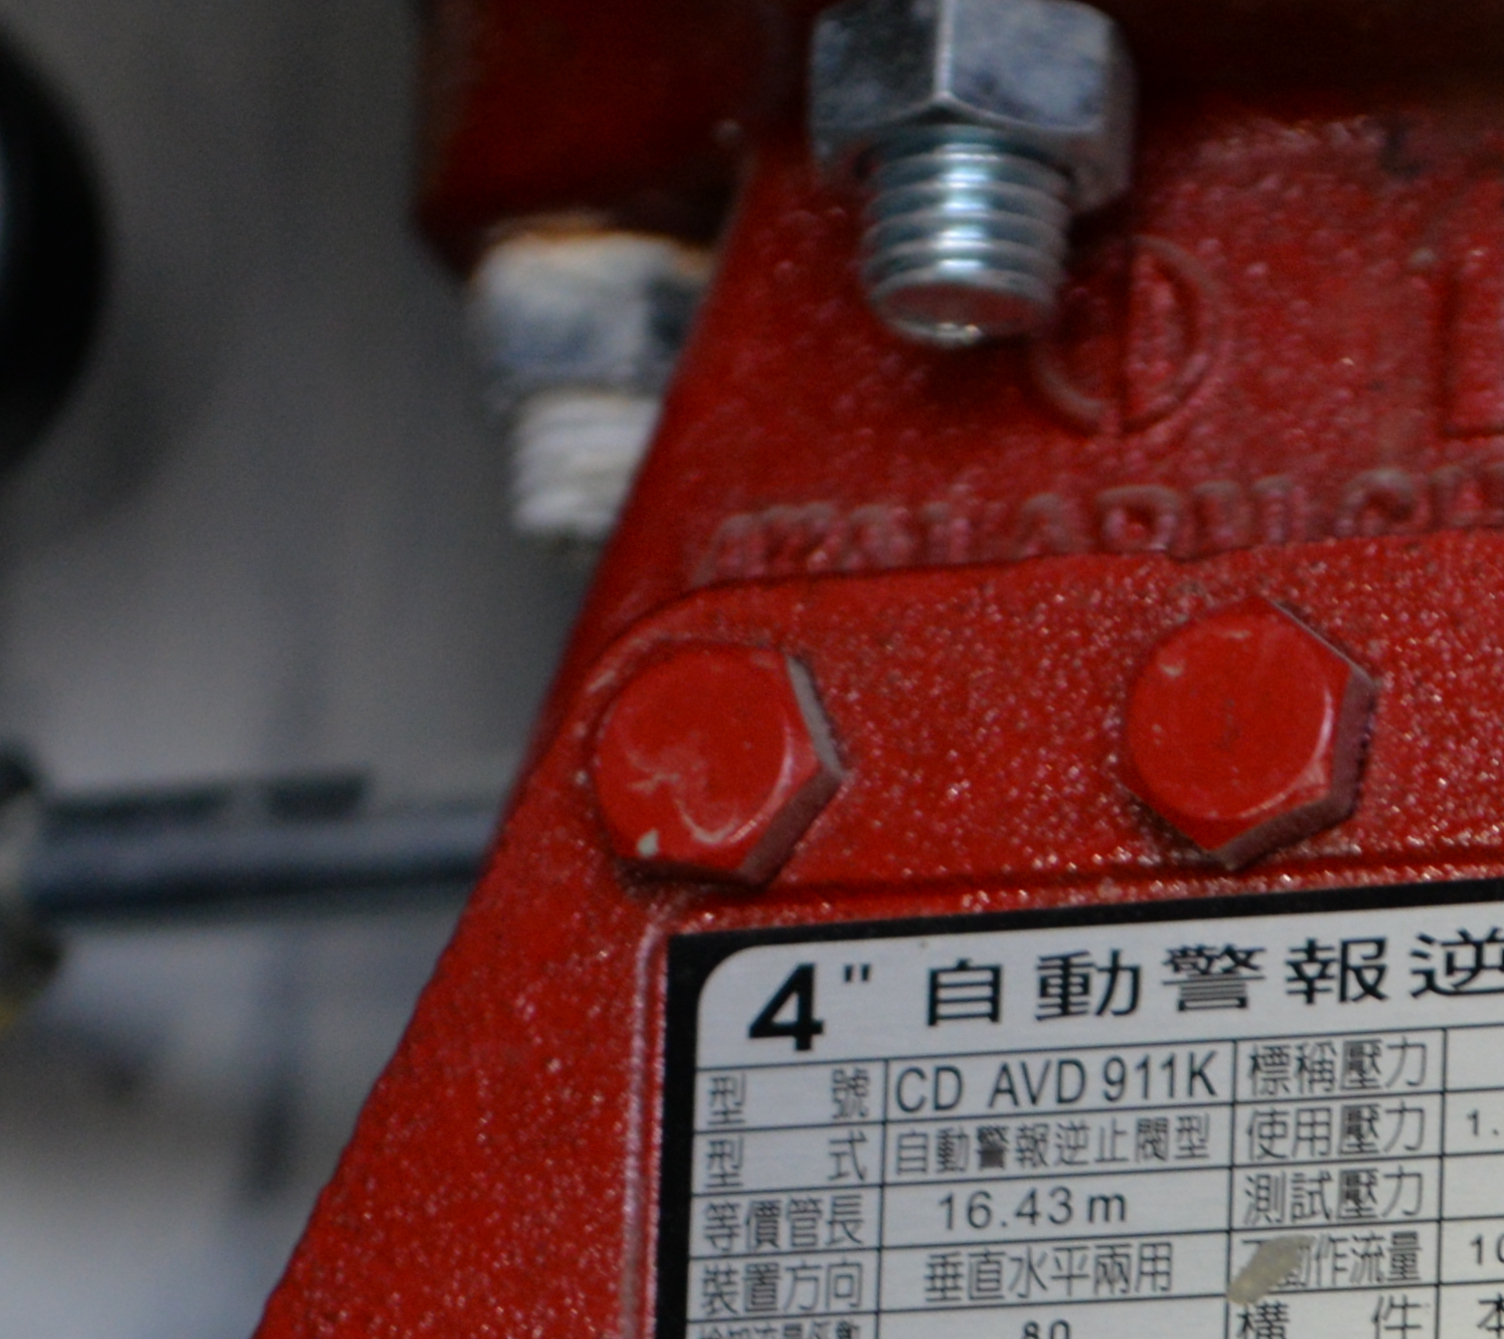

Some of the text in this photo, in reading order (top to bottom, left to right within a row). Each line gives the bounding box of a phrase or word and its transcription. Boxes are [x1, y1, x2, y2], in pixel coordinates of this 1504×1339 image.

[1247, 1036, 1429, 1095] 標稱壓力
[896, 1113, 1210, 1176] 自動警報逆止閥型
[1246, 1101, 1427, 1161] 使用壓力
[1244, 1165, 1425, 1227] 測試壓力
[700, 1258, 865, 1317] 裝置方向
[924, 1241, 1174, 1303] 垂直水平兩用
